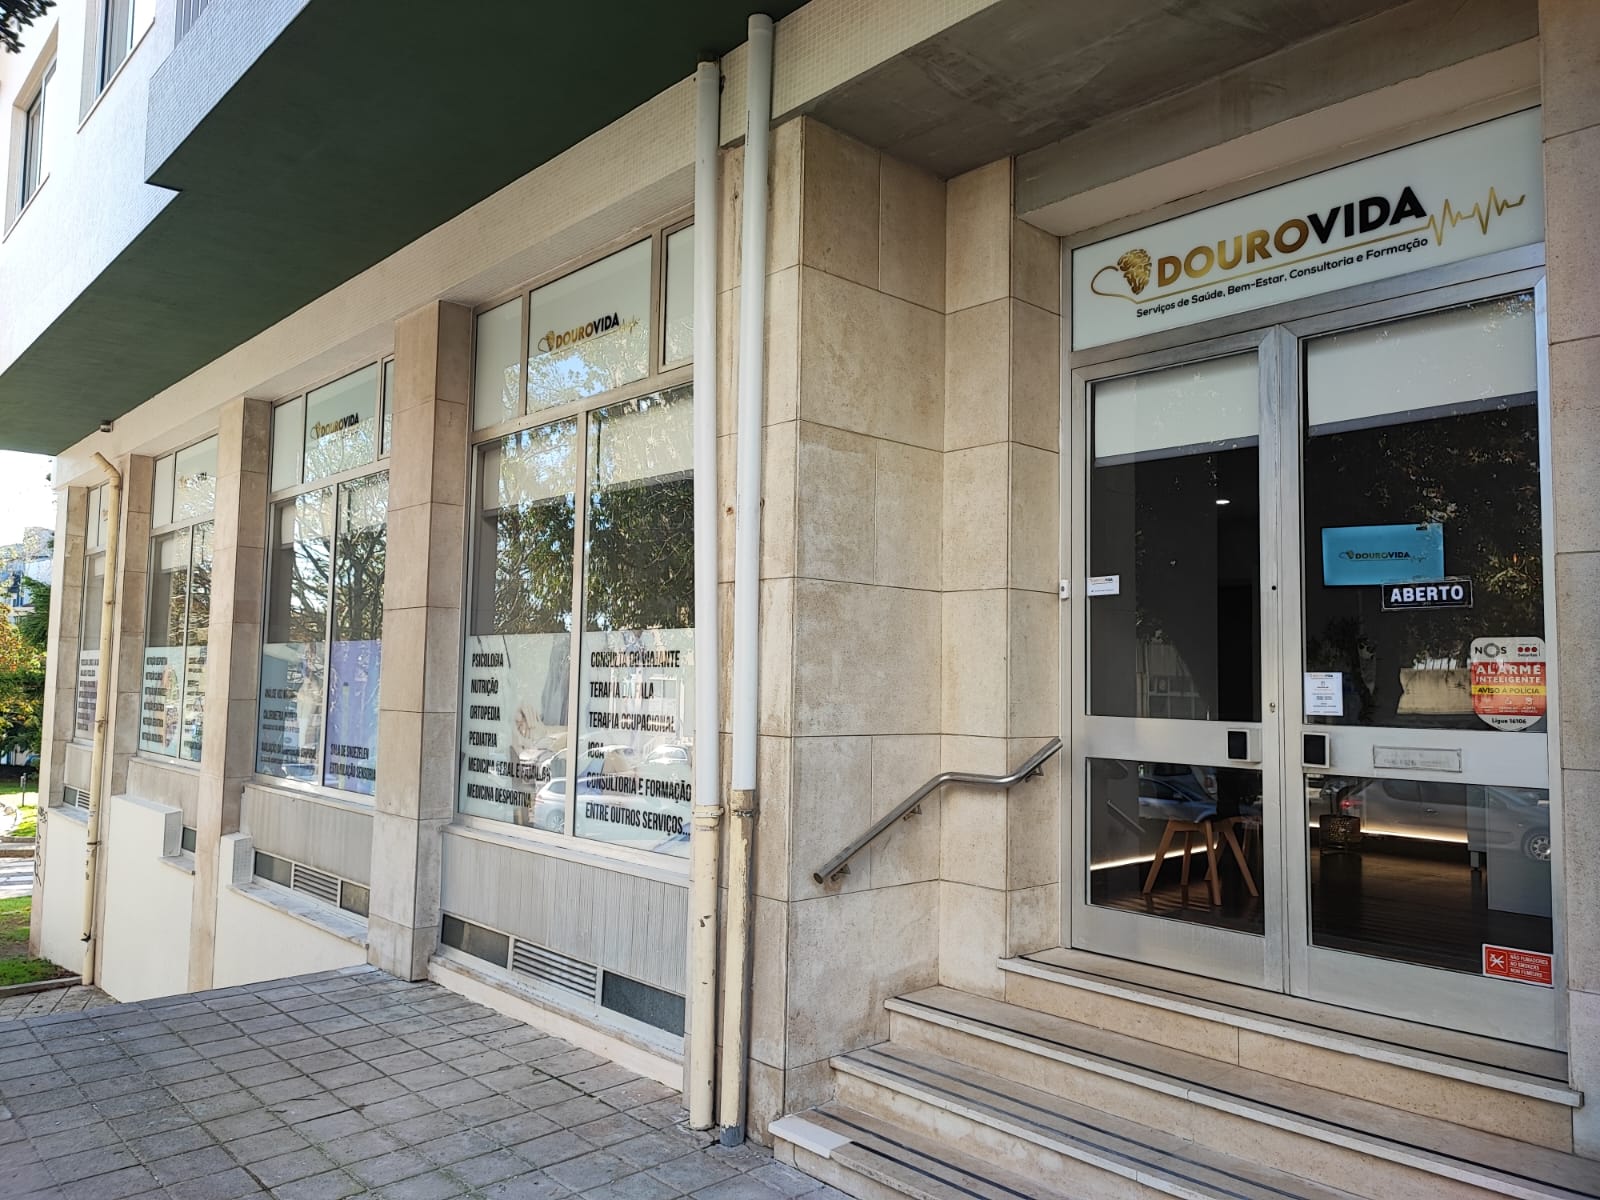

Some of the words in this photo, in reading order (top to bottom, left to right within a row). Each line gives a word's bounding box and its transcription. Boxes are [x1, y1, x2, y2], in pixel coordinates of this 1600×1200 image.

[1157, 185, 1427, 288] DOUROVIDA
[1136, 302, 1176, 318] Serviços
[1177, 297, 1190, 308] de
[1191, 287, 1226, 304] Saúde,
[1227, 274, 1288, 295] Bem-Estar,
[1289, 256, 1354, 280] Consultoria
[1356, 253, 1364, 263] e
[1366, 237, 1428, 260] Formação
[556, 312, 620, 349] DOUROVIDA
[321, 412, 359, 437] DOUROVIDA
[1355, 551, 1411, 560] DOUROVIDA
[1390, 585, 1464, 603] ABERTO
[590, 650, 628, 668] CONSULTA
[641, 650, 681, 668] VIAJANTE
[1475, 642, 1507, 658] NOS
[471, 653, 504, 668] PSICOLOGIA
[1476, 664, 1541, 675] ALARME
[470, 677, 499, 697] NUTRIÇÃO
[1476, 676, 1541, 684] INTELIGENTE
[590, 682, 621, 698] TERAPIA
[1509, 686, 1540, 694] POLÍCIA
[469, 705, 500, 721] ORTOPEDIA
[1491, 717, 1508, 725] Ligue
[589, 712, 619, 729] TERAPIA
[621, 713, 676, 733] OCUPACIONAL
[468, 731, 498, 748] PEDIATRIA
[468, 757, 495, 774] MEDICINA
[496, 761, 515, 778] GERAL
[516, 764, 520, 779] E
[466, 783, 495, 802] MEDICINA
[495, 788, 532, 808] DESPORTIVA
[586, 772, 637, 795] CONSULTORIA
[639, 778, 644, 796] E
[645, 780, 692, 804] FORMAÇÃO
[585, 802, 610, 822] ENTRE
[610, 806, 641, 828] OUTROS
[642, 811, 691, 837] SERVIÇOS...
